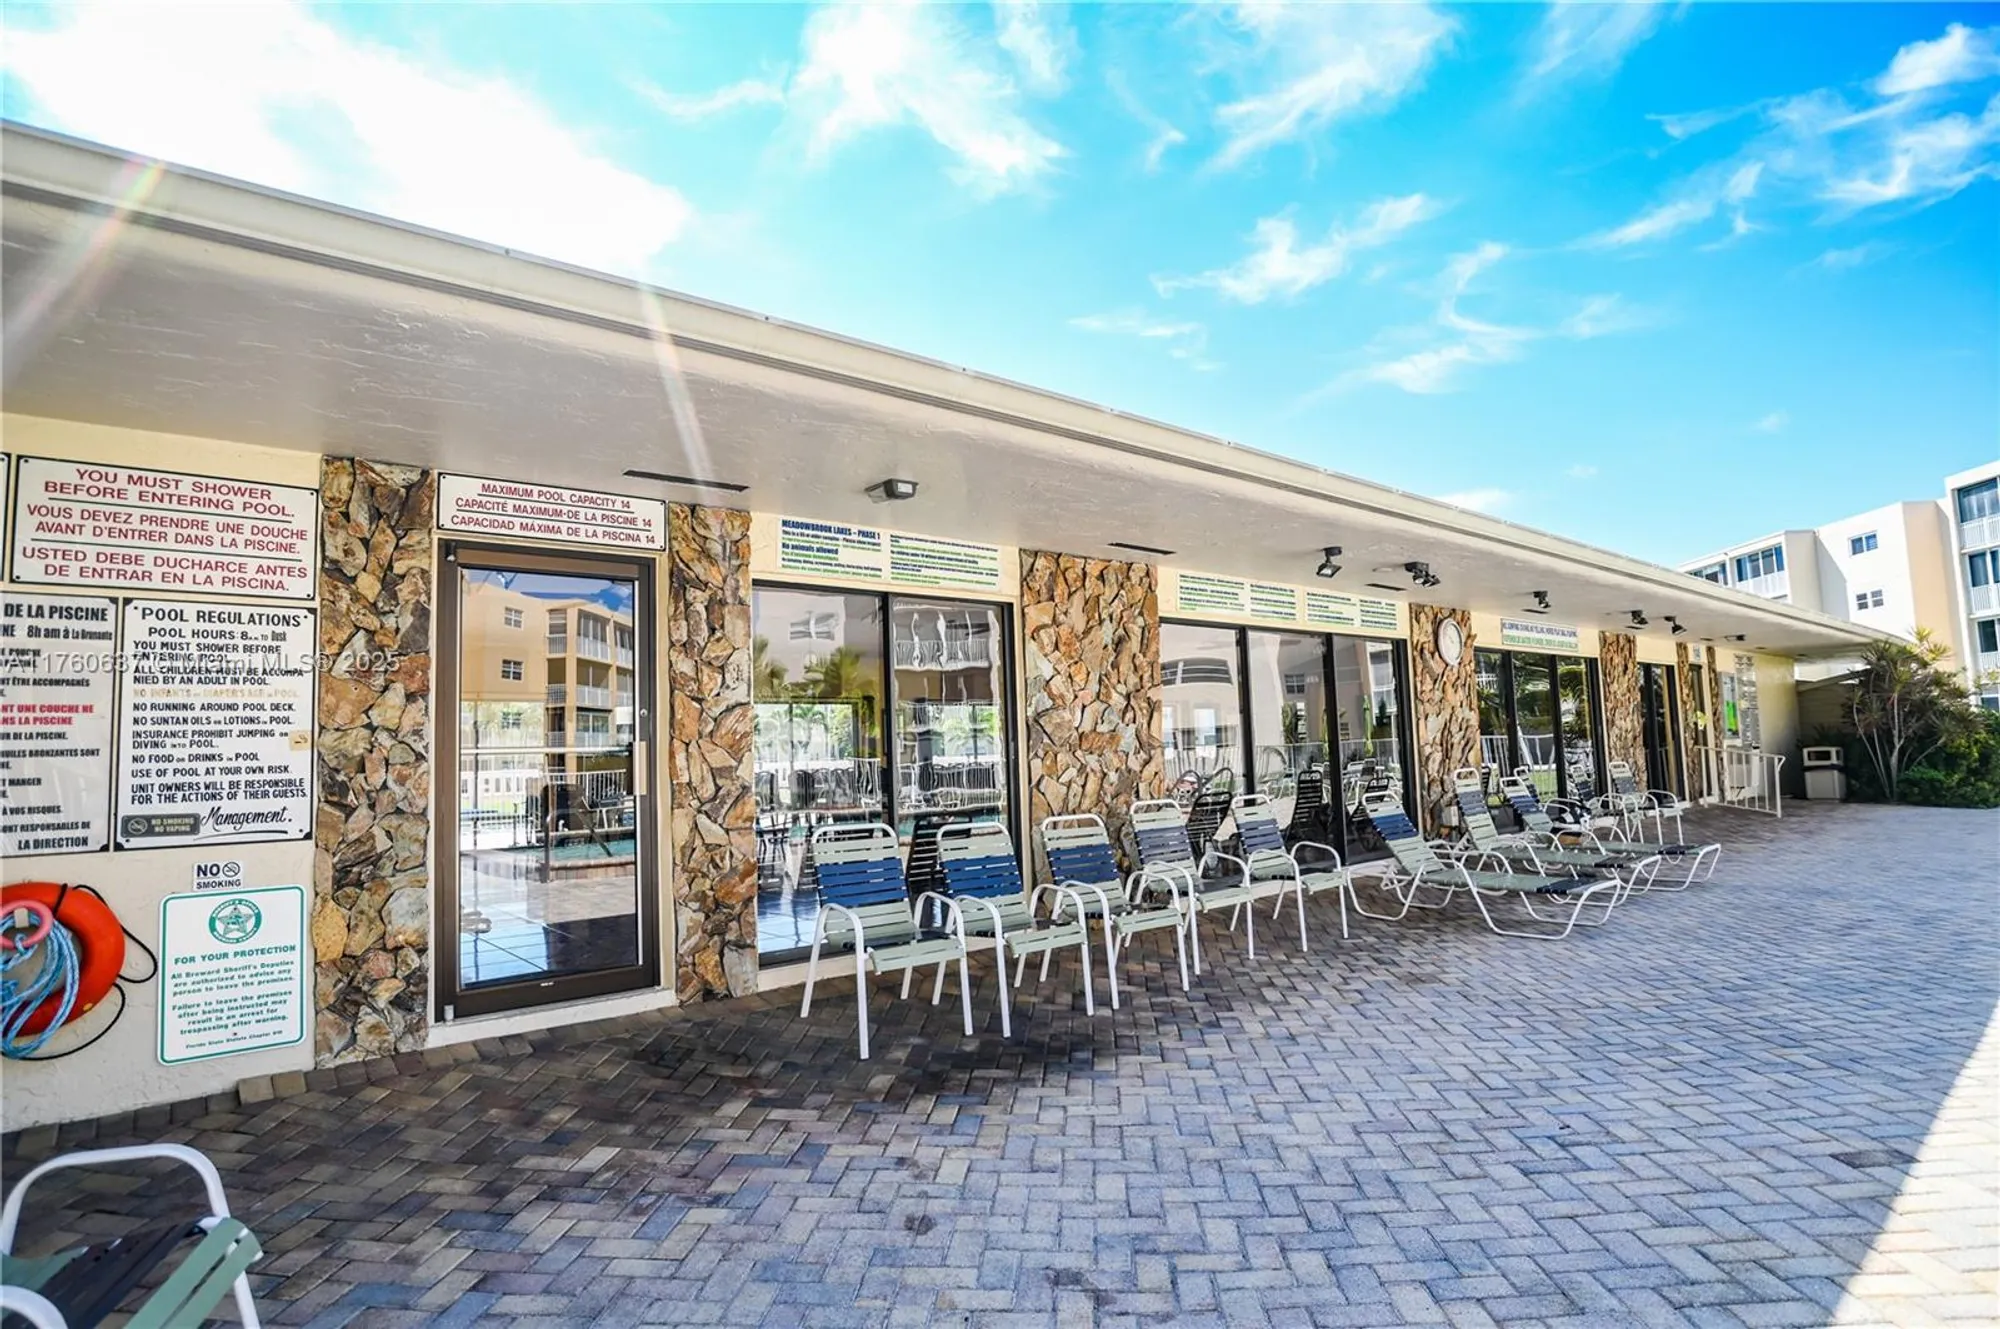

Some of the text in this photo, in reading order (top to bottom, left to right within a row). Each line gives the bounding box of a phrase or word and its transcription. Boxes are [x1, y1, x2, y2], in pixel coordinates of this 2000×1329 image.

[76, 468, 271, 501] YOU MUST SHOWER
[44, 481, 294, 518] BEFORE ENTERING POOL.
[481, 483, 631, 509] MAXIMUM POOL CAPACITY 14
[455, 498, 508, 512] CAPACITÉ
[585, 511, 597, 522] LA
[601, 514, 638, 526] PISCINE
[642, 518, 652, 528] 14
[27, 504, 308, 541] VOUS DEVEZ PRENDRE UNE DOUCHE
[782, 519, 832, 533] MEADOWBROOK
[834, 527, 852, 535] LAKES
[858, 529, 876, 539] PHASE
[451, 515, 655, 544] CAPACIDAD MÁXIMA DE LA PISCINA 14
[35, 521, 300, 555] AVANT D'ENTRER DANS LA PISCINE.
[791, 544, 814, 552] animals
[816, 546, 838, 555] allowed
[22, 546, 308, 579] USTED DEBE DUCHARCE ANTES
[44, 564, 289, 592] DE ENTRAR EN LA PISCINA.
[4, 603, 108, 621] DE LA PISCINE
[142, 608, 301, 627] POOL REGULATIONS
[44, 628, 60, 638] am
[149, 627, 186, 638] POOL
[133, 640, 281, 654] YOU MUST SHOWER BEFORE
[246, 668, 258, 676] BE
[133, 675, 239, 686] NIED BY AN ADULT IN
[17, 704, 37, 713] UNE
[39, 704, 79, 713] COUCHE
[82, 704, 94, 713] NE
[133, 703, 147, 711] NO
[150, 702, 195, 711] RUNNING
[200, 702, 239, 711] AROUND
[243, 703, 267, 711] POOL
[19, 717, 30, 725] LA
[33, 717, 73, 725] PISCINE
[133, 716, 261, 726] NO SUNTAN OILS LOTIONS
[13, 732, 23, 740] DE
[24, 732, 34, 740] LA
[132, 729, 275, 739] INSURANCE PROHIBIT JUMPING
[132, 740, 167, 749] DIVING
[80, 748, 100, 757] SONT
[132, 753, 259, 764] NO FOOD DRINKS POOL
[132, 766, 263, 778] USE OF POOL AT YOUR OWN
[8, 778, 42, 786] MANGER
[132, 778, 304, 793] UNIT OWNERS WILL BE RESPONSIBLE
[131, 794, 152, 805] FOR
[157, 793, 178, 803] THE
[181, 792, 223, 802] ACTIONS
[227, 791, 238, 800] OF
[244, 789, 270, 799] THEIR
[9, 806, 25, 815] VOS
[81, 821, 90, 829] DE
[201, 805, 292, 832] Management.
[18, 836, 88, 850] LA DIRECTION
[196, 864, 220, 878] NO
[196, 879, 241, 890] SMOKING
[174, 945, 296, 965] FOR YOUR PROTECTION
